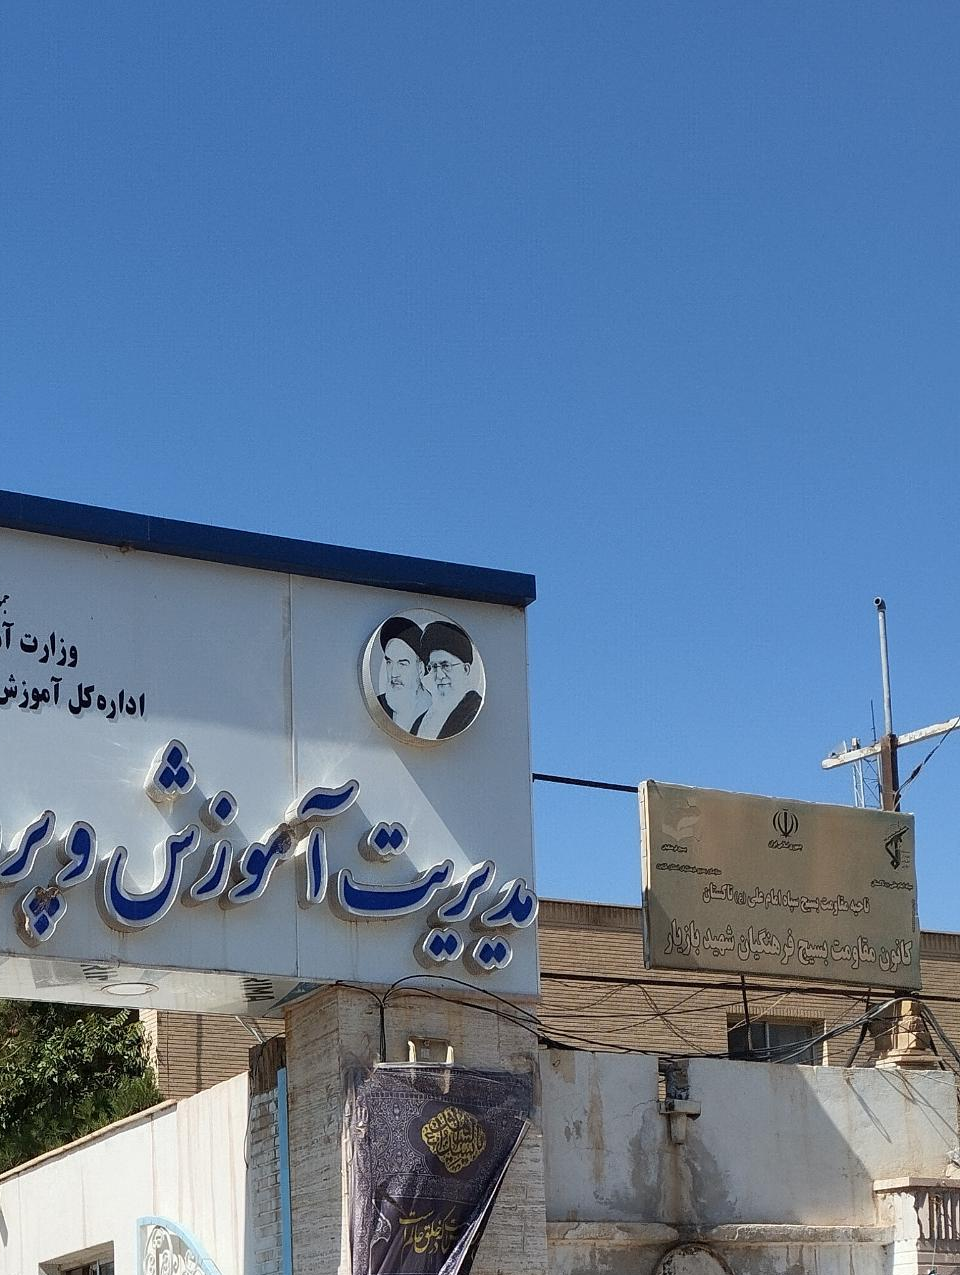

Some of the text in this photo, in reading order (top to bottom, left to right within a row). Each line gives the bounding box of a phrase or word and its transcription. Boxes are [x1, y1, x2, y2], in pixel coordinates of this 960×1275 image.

[19, 632, 78, 668] وزارت
[100, 738, 361, 931] آموزش
[55, 821, 98, 888] و
[337, 821, 540, 972] مدیریت
[702, 882, 734, 903] تاکستان
[800, 896, 819, 914] بسیج
[703, 925, 735, 957] شهید
[738, 926, 795, 966] فرهنگیان
[798, 938, 829, 966] بسیج
[831, 935, 877, 969] مقاومت
[878, 938, 913, 972] کانون
